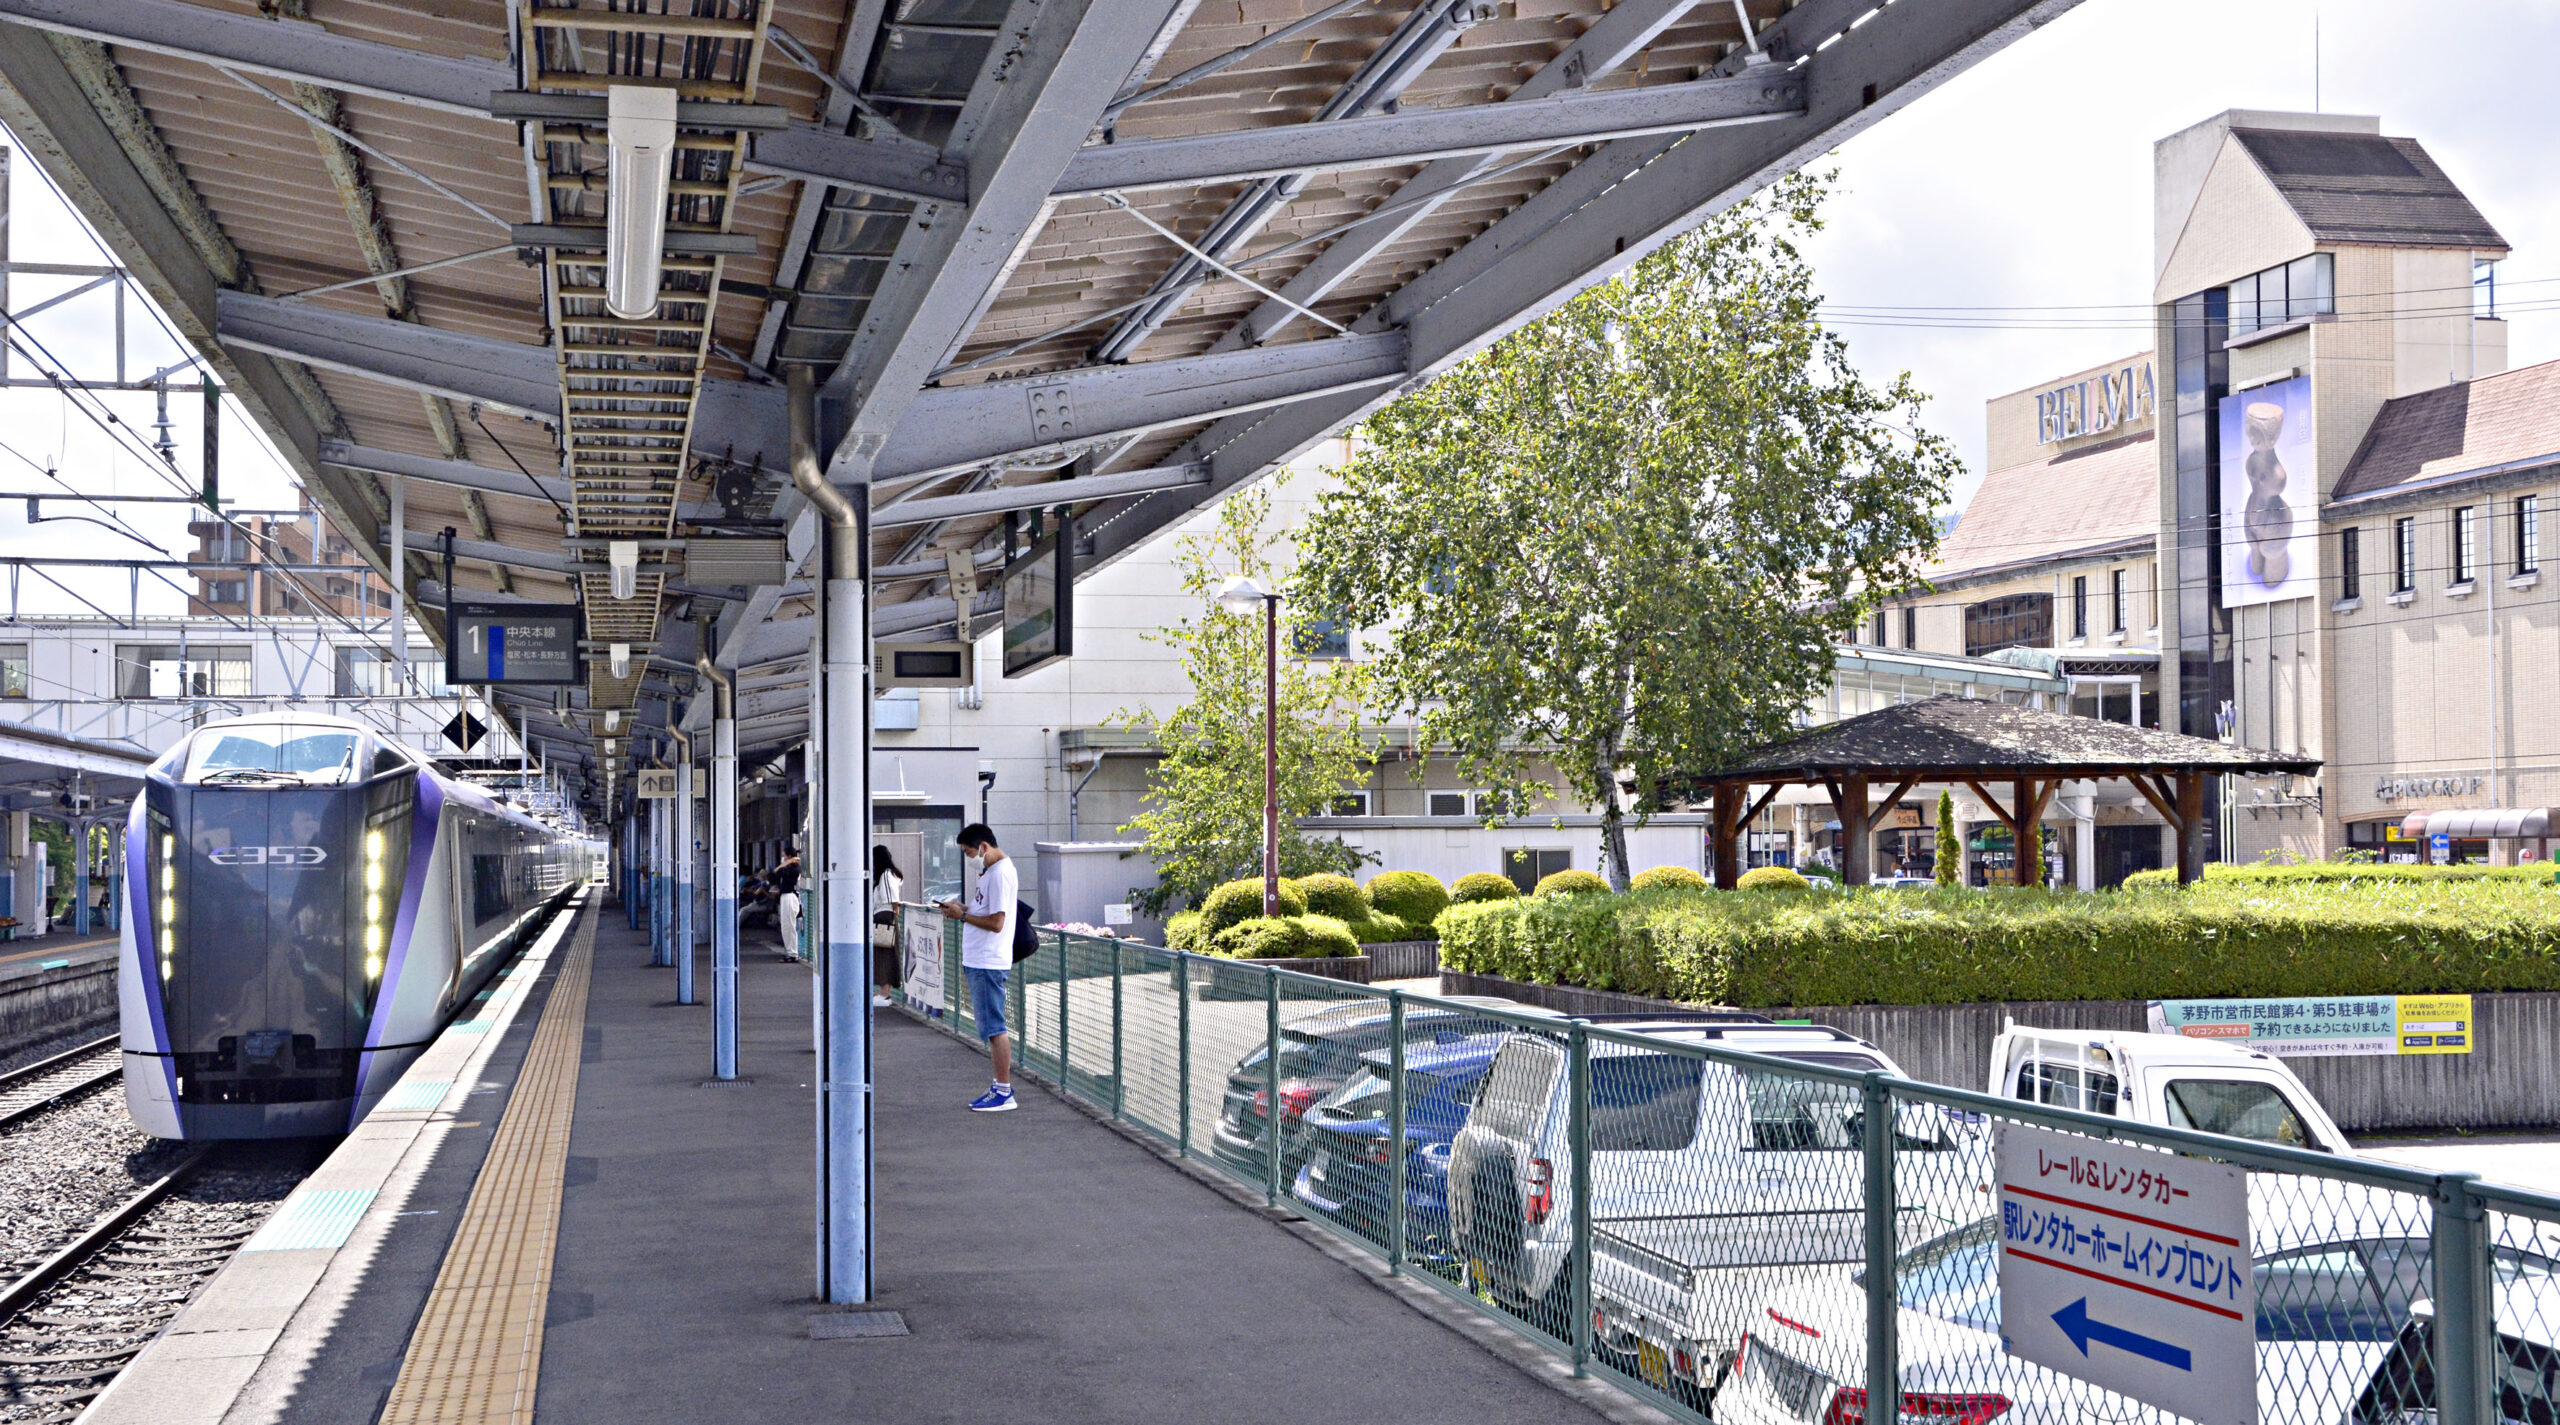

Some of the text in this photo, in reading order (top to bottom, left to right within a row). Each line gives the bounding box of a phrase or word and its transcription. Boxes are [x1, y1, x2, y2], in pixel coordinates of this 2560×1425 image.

[467, 625, 479, 654] 1
[506, 626, 556, 639] 中央本線
[527, 639, 544, 647] Line
[2375, 776, 2485, 800] ALPICO GROUP
[2181, 1002, 2391, 1021] 茅野市営市民館第4・第5駐車場が
[2253, 1022, 2391, 1037] 予約できるようになりました
[2038, 1148, 2190, 1205] レール&レンタカー
